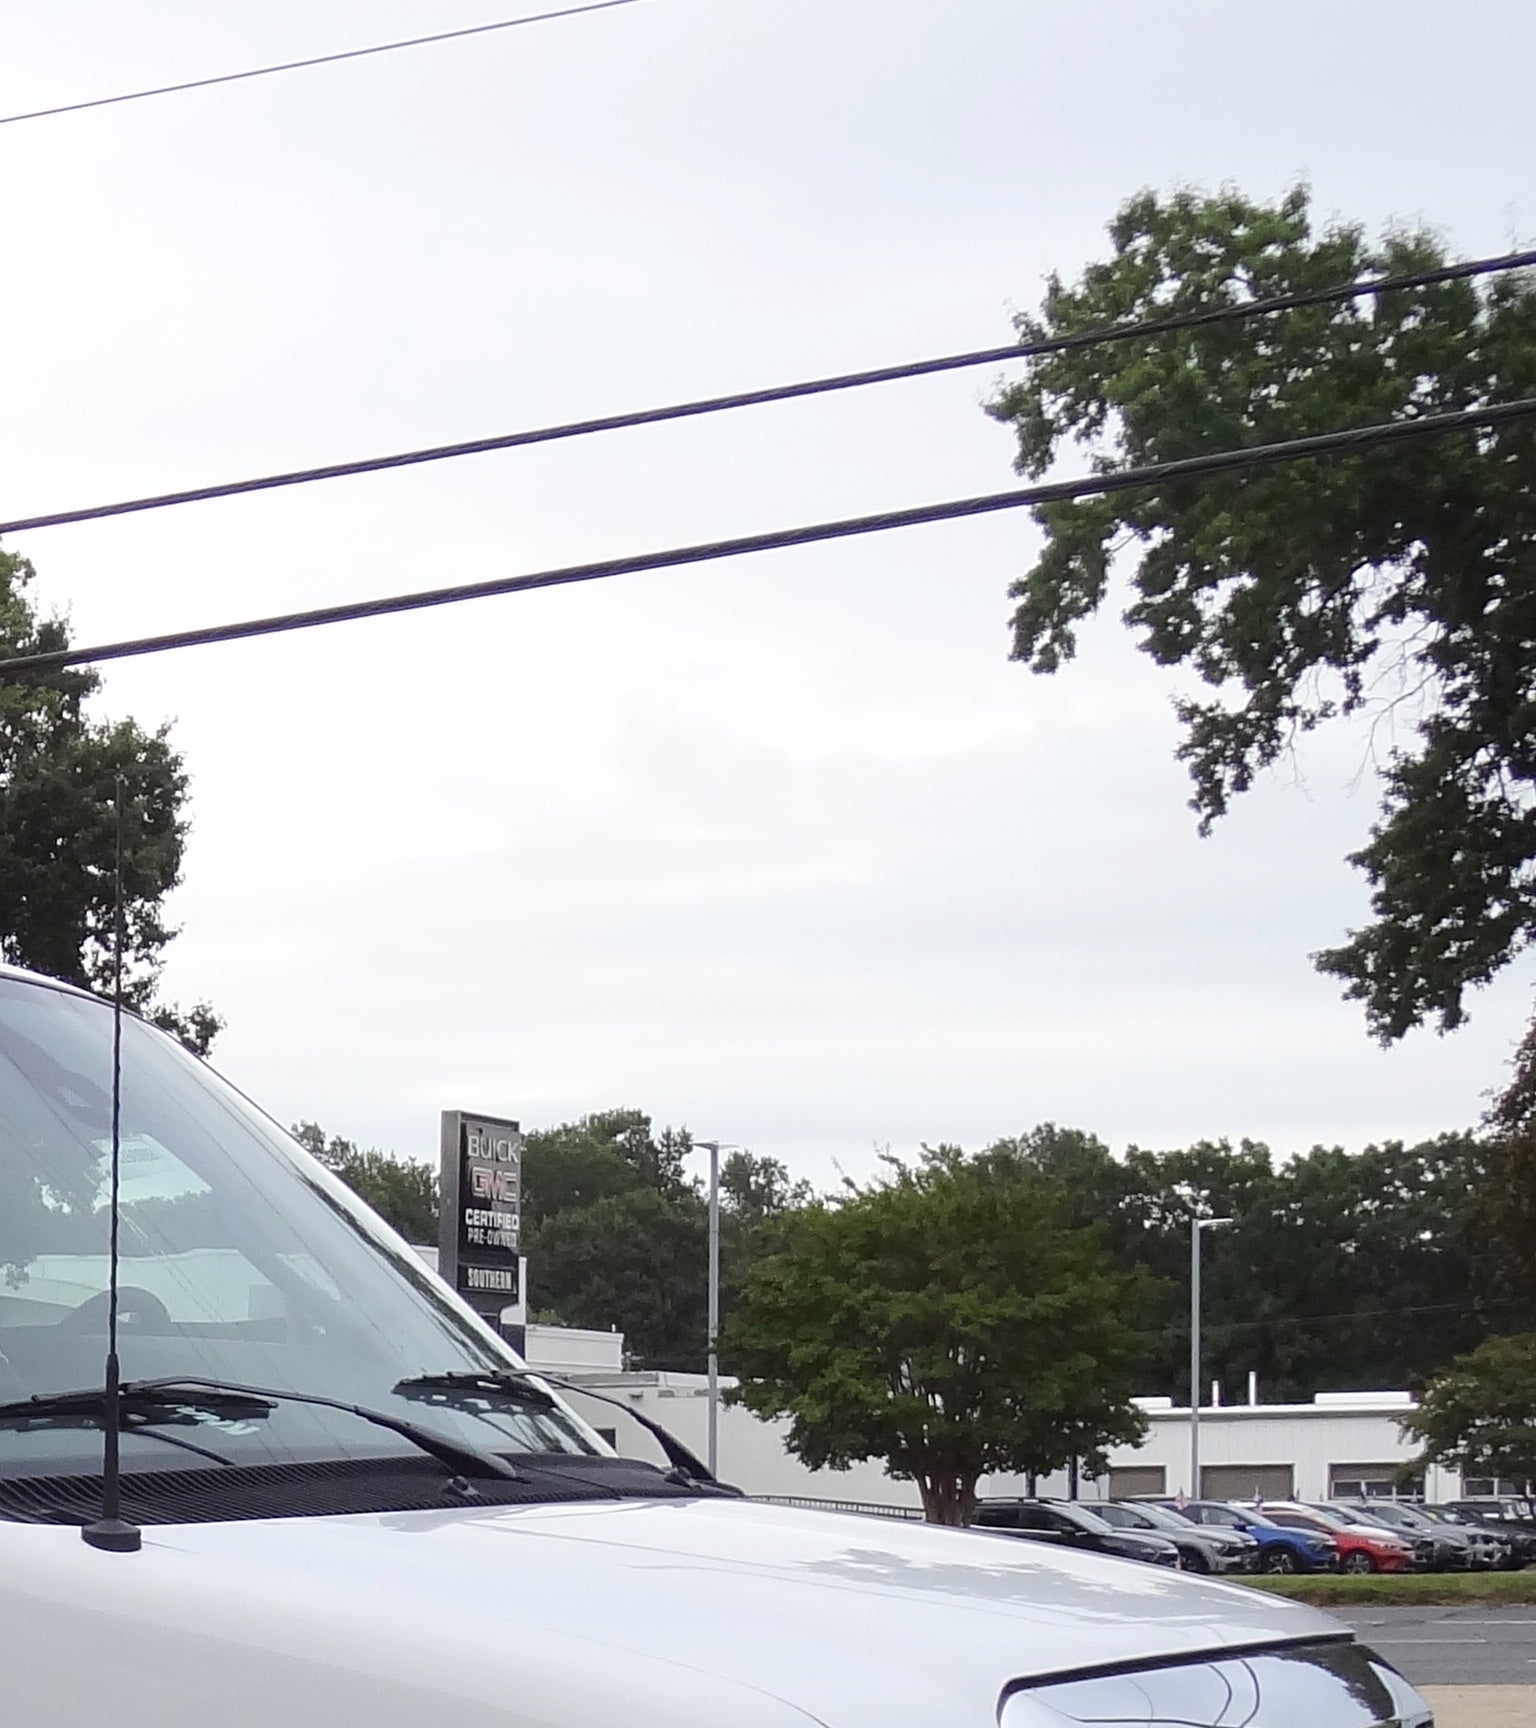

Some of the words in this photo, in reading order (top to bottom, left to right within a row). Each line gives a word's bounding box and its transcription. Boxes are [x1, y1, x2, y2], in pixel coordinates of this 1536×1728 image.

[468, 1135, 519, 1163] BUICK
[472, 1166, 517, 1201] GMC
[465, 1208, 520, 1230] CERTIFIED
[468, 1227, 517, 1248] PRE-OWNED
[468, 1268, 512, 1289] SOUTHERN
